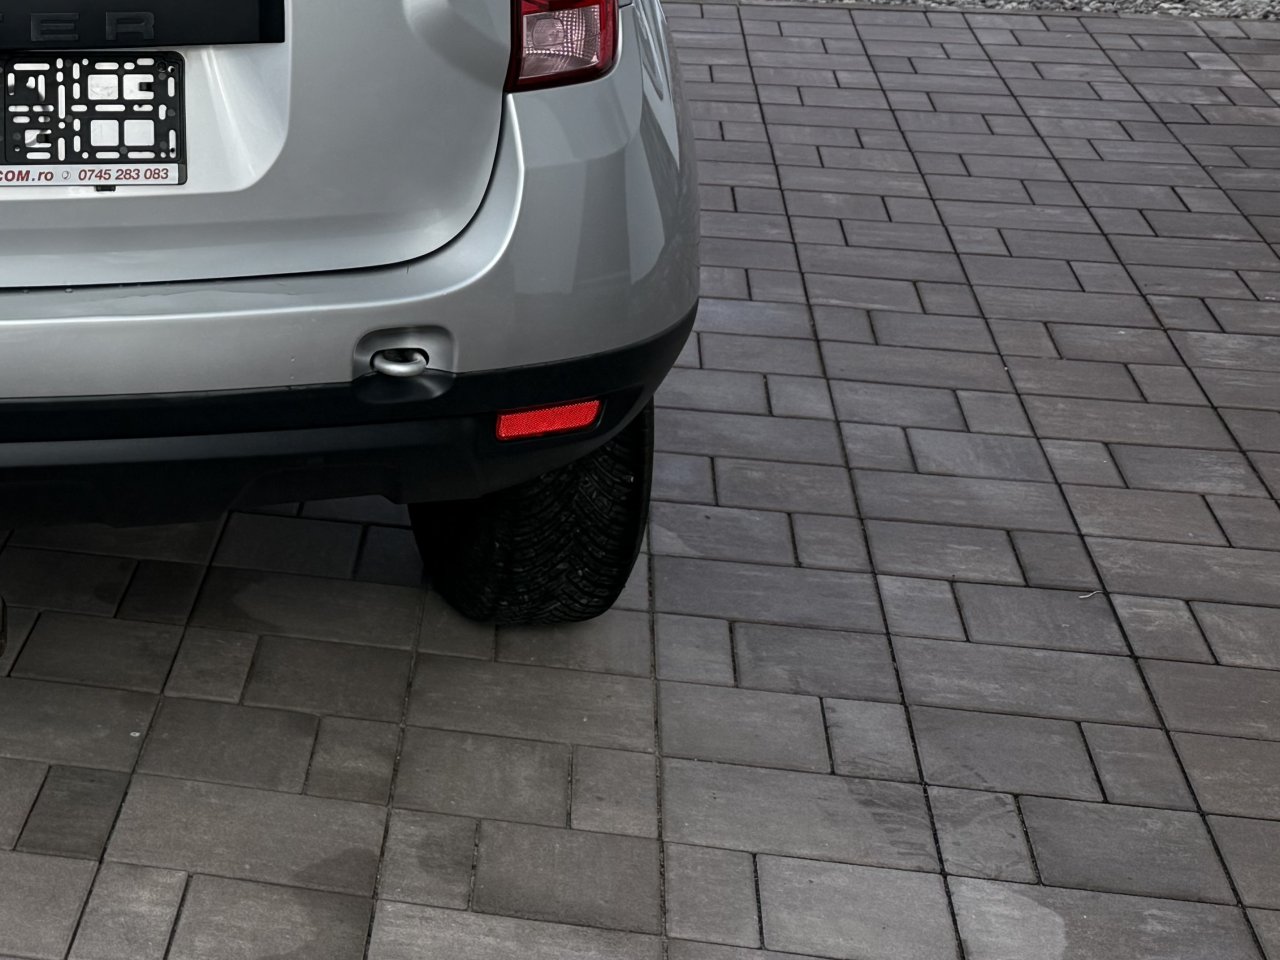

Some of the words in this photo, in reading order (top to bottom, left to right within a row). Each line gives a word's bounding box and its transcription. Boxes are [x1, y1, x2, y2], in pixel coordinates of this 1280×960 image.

[78, 168, 112, 181] 0745
[115, 168, 140, 181] 283
[144, 168, 169, 180] 083
